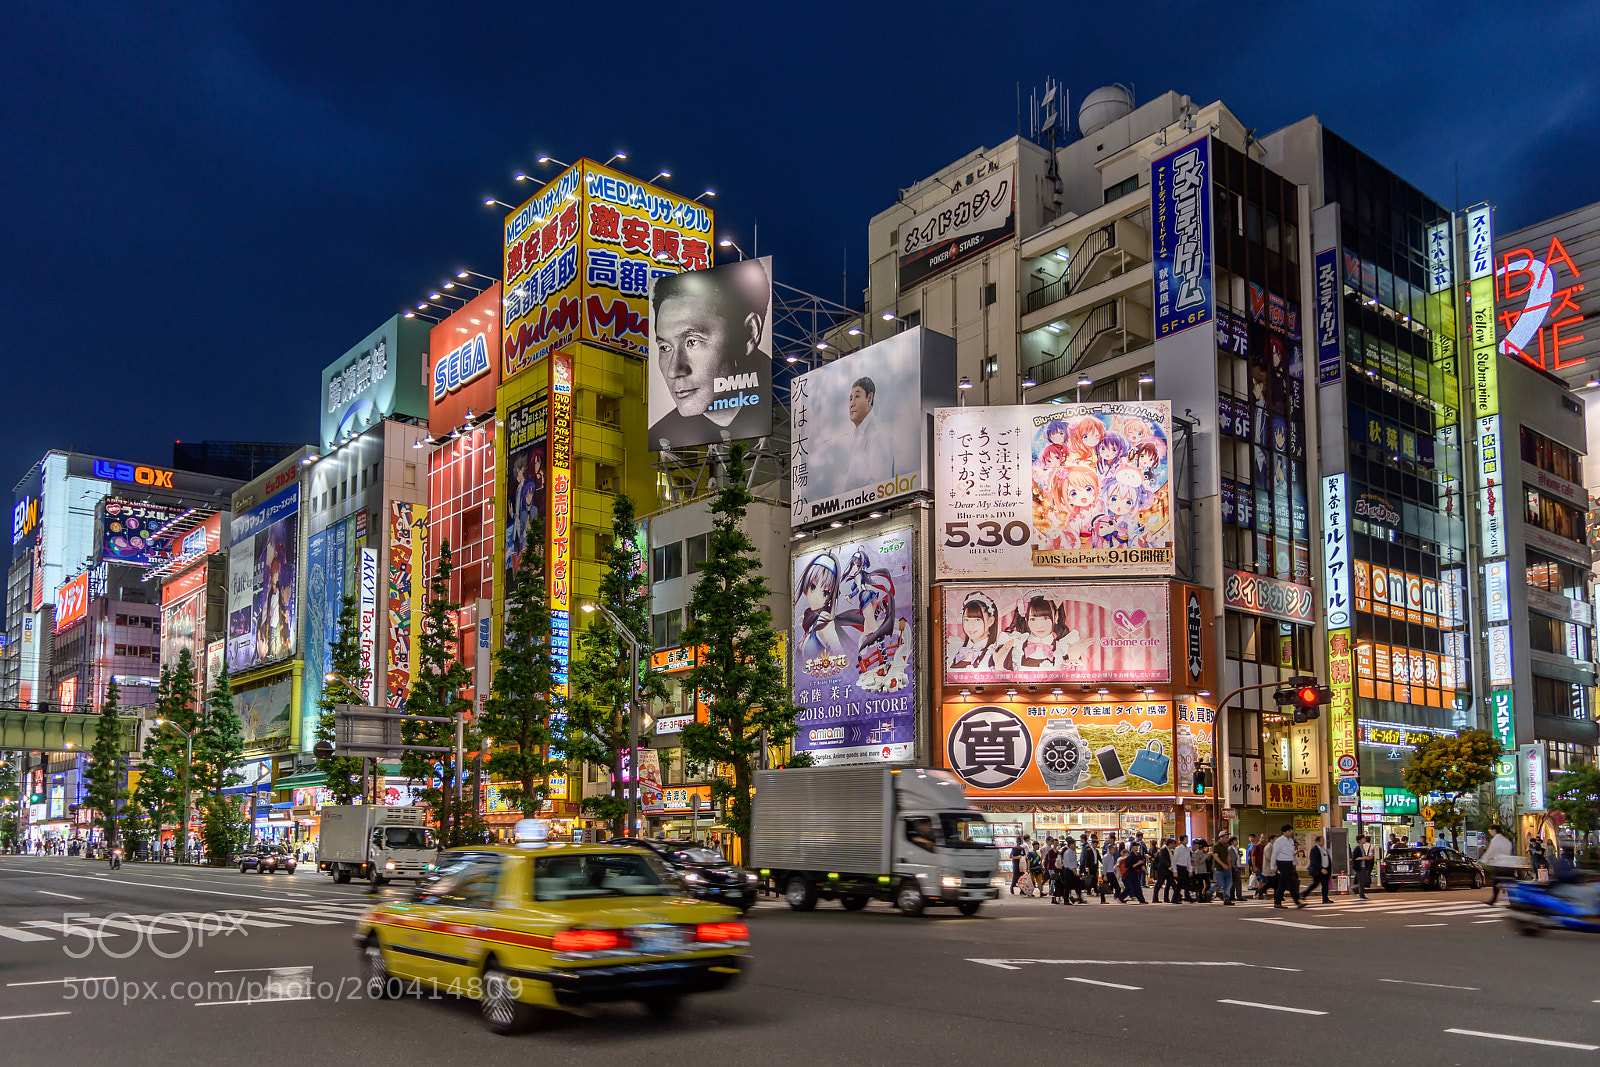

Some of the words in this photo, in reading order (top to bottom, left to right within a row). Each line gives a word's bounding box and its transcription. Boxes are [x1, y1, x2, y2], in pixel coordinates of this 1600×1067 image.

[506, 166, 580, 248] MEDIAリサイクル
[587, 171, 711, 234] MEDIAリサイクル
[904, 180, 1008, 253] メイドカジノ
[1158, 174, 1167, 254] トレーディングカードゲーム
[506, 201, 579, 284] 激安販売
[589, 202, 710, 271] 激安販売
[929, 250, 949, 268] POKER
[959, 235, 980, 253] STARS
[505, 243, 578, 330] 高額買取
[587, 248, 679, 299] 高額
[1159, 268, 1169, 318] 秋葉原店
[504, 295, 580, 374] Mulan
[1161, 310, 1206, 334] 5F・6F
[1476, 307, 1487, 344] Yellow
[599, 333, 639, 350] ムーラン
[1232, 334, 1248, 356] 7F
[435, 332, 492, 402] SEGA
[1477, 352, 1490, 411] Submarine
[713, 372, 759, 393] DMM
[554, 394, 570, 404] DVD
[708, 391, 760, 411] .make
[553, 410, 570, 421] ゲーム
[556, 419, 568, 428] CD
[1234, 416, 1250, 438] 6F
[1482, 417, 1494, 426] 5F
[553, 427, 570, 436] アイドル
[553, 435, 570, 445] アニメ
[553, 443, 569, 453] コミック
[791, 377, 809, 525] 次は太陽か。
[978, 427, 993, 482] うさぎ
[995, 429, 1013, 497] ご注文は
[1482, 434, 1497, 475] 秋葉館
[876, 474, 918, 499] solar
[976, 501, 991, 511] My
[1236, 502, 1253, 524] 5F
[1328, 478, 1341, 527] 喫茶室
[552, 473, 569, 605] お売り下さい!!
[944, 520, 1031, 548] 5.30
[363, 550, 375, 596] AKKY
[1037, 555, 1061, 565] DMS
[1062, 555, 1078, 564] Tea
[1326, 528, 1347, 609] ルノアール
[1226, 573, 1312, 618] メイドカジノ
[361, 607, 375, 670] Tax-free
[1101, 637, 1138, 648] @home
[1139, 637, 1161, 647] cafe
[667, 649, 691, 664] 吉野家
[1330, 633, 1351, 685] 免税
[361, 670, 373, 700] Sho
[799, 705, 842, 722] 2018.09
[846, 702, 861, 717] IN
[865, 696, 909, 715] STORE
[1027, 705, 1047, 717] 時計
[1050, 705, 1080, 716] バッグ
[1082, 705, 1112, 717] 貴金属
[1115, 705, 1144, 716] ダイヤ
[1147, 704, 1167, 716] 携帯
[1343, 687, 1352, 716] TAX
[809, 727, 845, 741] amiami
[1495, 694, 1510, 745] リバティー
[957, 718, 1026, 779] 質
[1301, 736, 1311, 776] ルノアール
[1342, 758, 1353, 768] 40
[666, 789, 688, 802] 吉野家
[1269, 783, 1294, 804] 免税
[1305, 785, 1317, 798] FREE
[1385, 794, 1417, 807] リバティー
